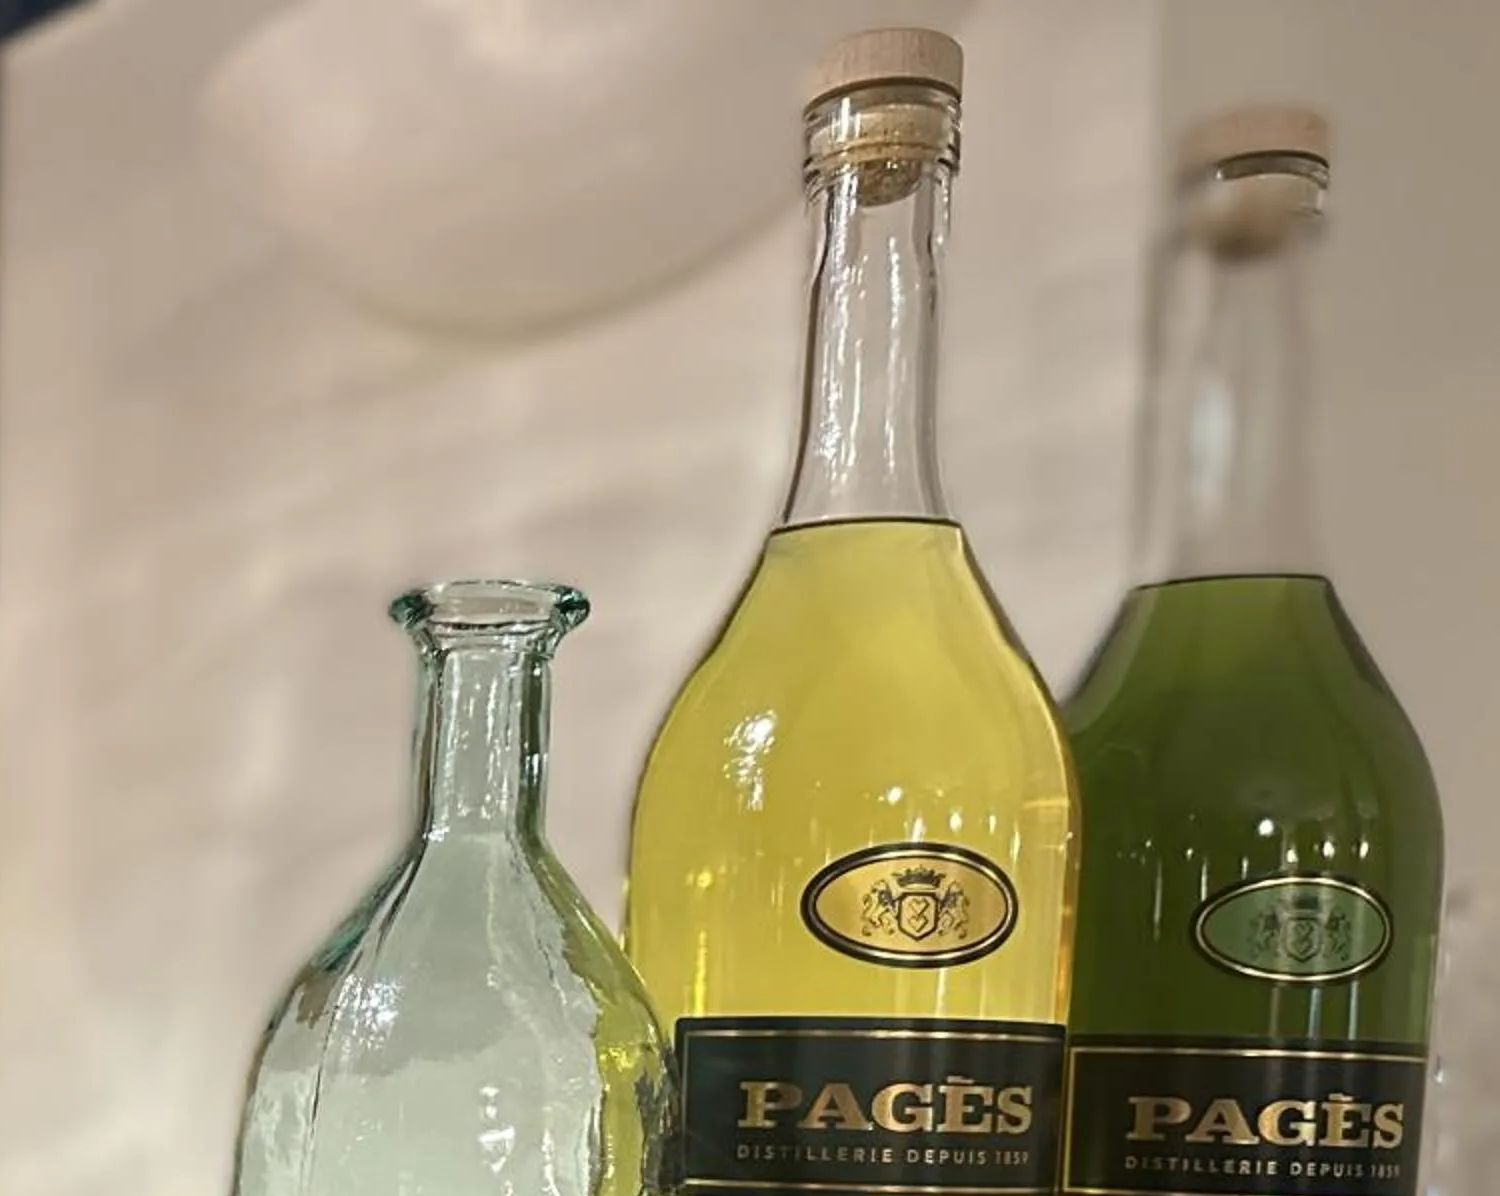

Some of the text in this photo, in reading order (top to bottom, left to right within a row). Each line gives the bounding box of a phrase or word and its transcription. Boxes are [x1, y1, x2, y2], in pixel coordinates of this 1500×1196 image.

[736, 1075, 1033, 1135] PAGÈS
[1125, 1092, 1404, 1150] PAGÈS
[736, 1144, 894, 1164] DISTILLERIE
[906, 1148, 987, 1165] DEPUIS
[1124, 1155, 1277, 1176] DISTILLERIE
[1289, 1161, 1364, 1178] DEPUIS
